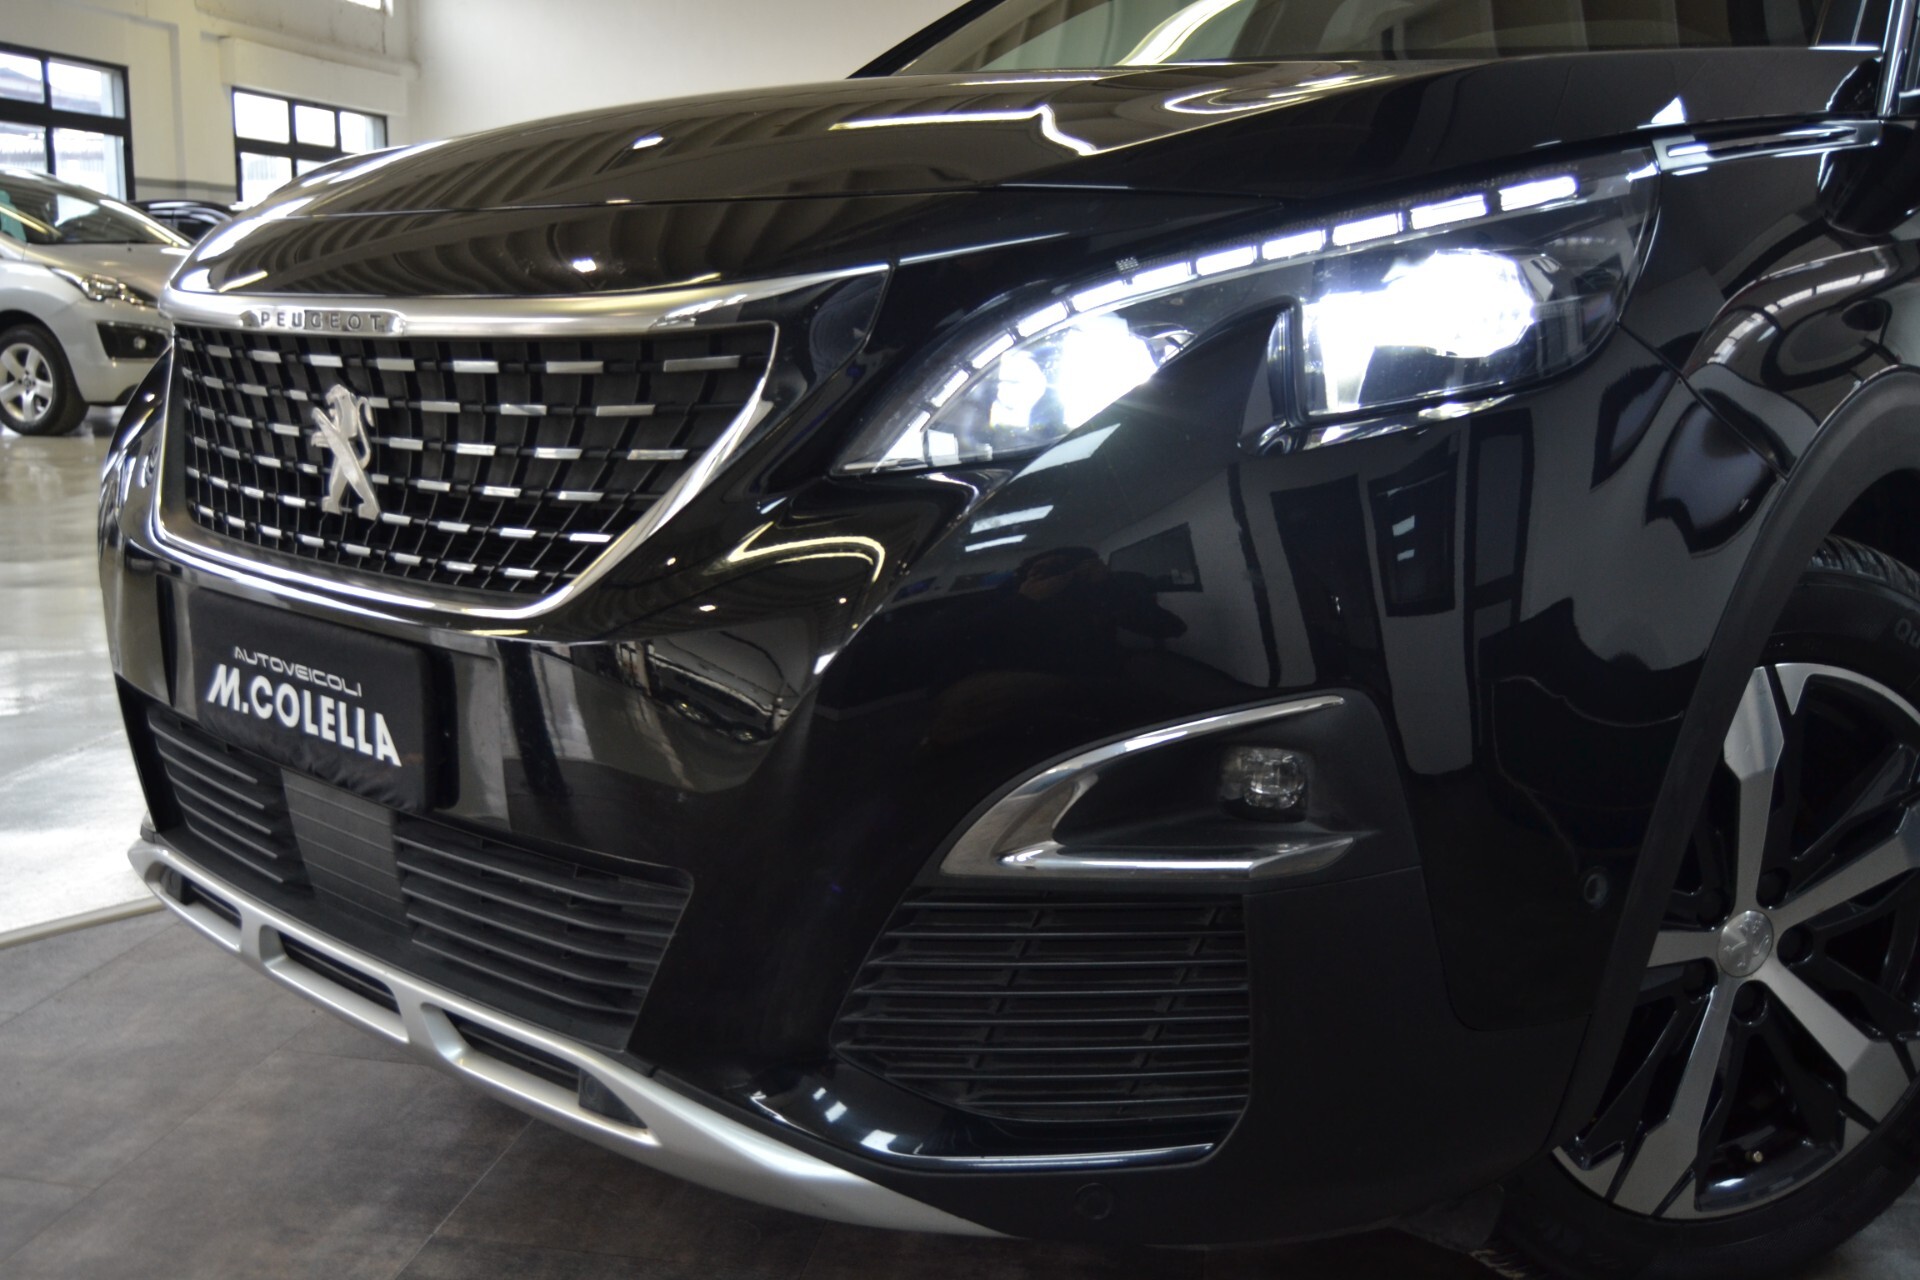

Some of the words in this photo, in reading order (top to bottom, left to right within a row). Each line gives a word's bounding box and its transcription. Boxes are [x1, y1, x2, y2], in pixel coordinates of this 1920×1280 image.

[260, 311, 381, 331] PEUGEOT
[234, 646, 362, 697] AUTOVEICOLI
[207, 664, 402, 767] M.COLELLA
